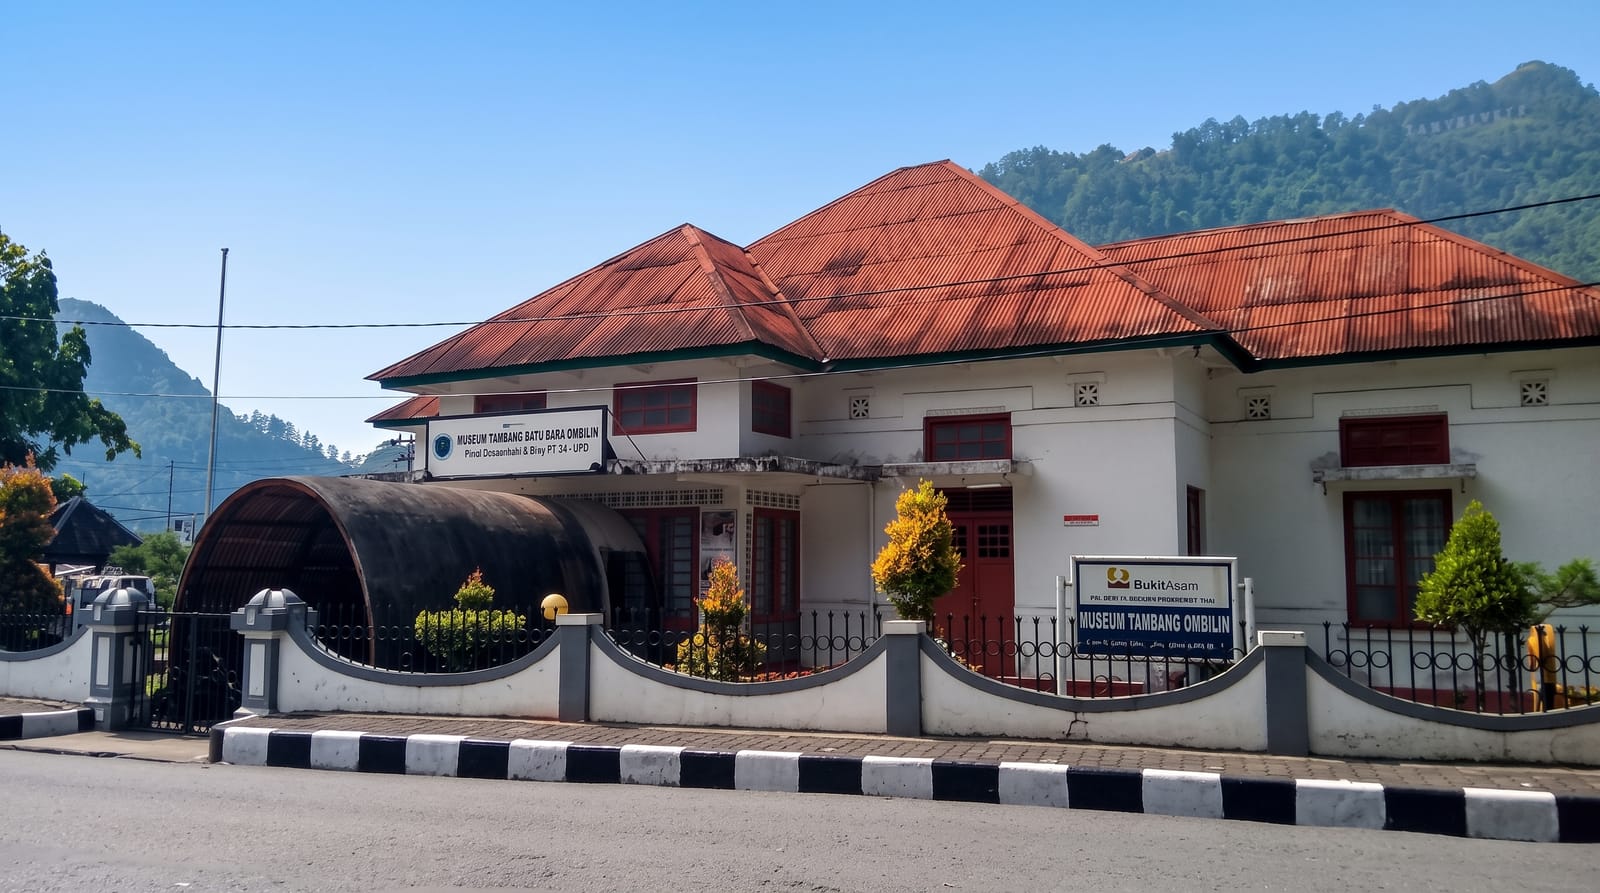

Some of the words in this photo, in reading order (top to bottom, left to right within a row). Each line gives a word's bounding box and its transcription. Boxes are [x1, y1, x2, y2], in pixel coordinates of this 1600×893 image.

[457, 433, 487, 445] MUSEUM
[489, 431, 523, 443] TAMBANG
[525, 430, 544, 441] BATU
[546, 429, 566, 440] BARA
[567, 427, 599, 439] OMBILIN
[523, 446, 528, 455] &
[547, 444, 557, 453] PT
[558, 444, 567, 453] 34
[573, 443, 589, 453] UPD
[1134, 579, 1199, 591] BukitAsam
[1080, 611, 1125, 630] MUSEUM
[1128, 612, 1181, 632] TAMBANG
[1184, 614, 1230, 633] OMBILIN
